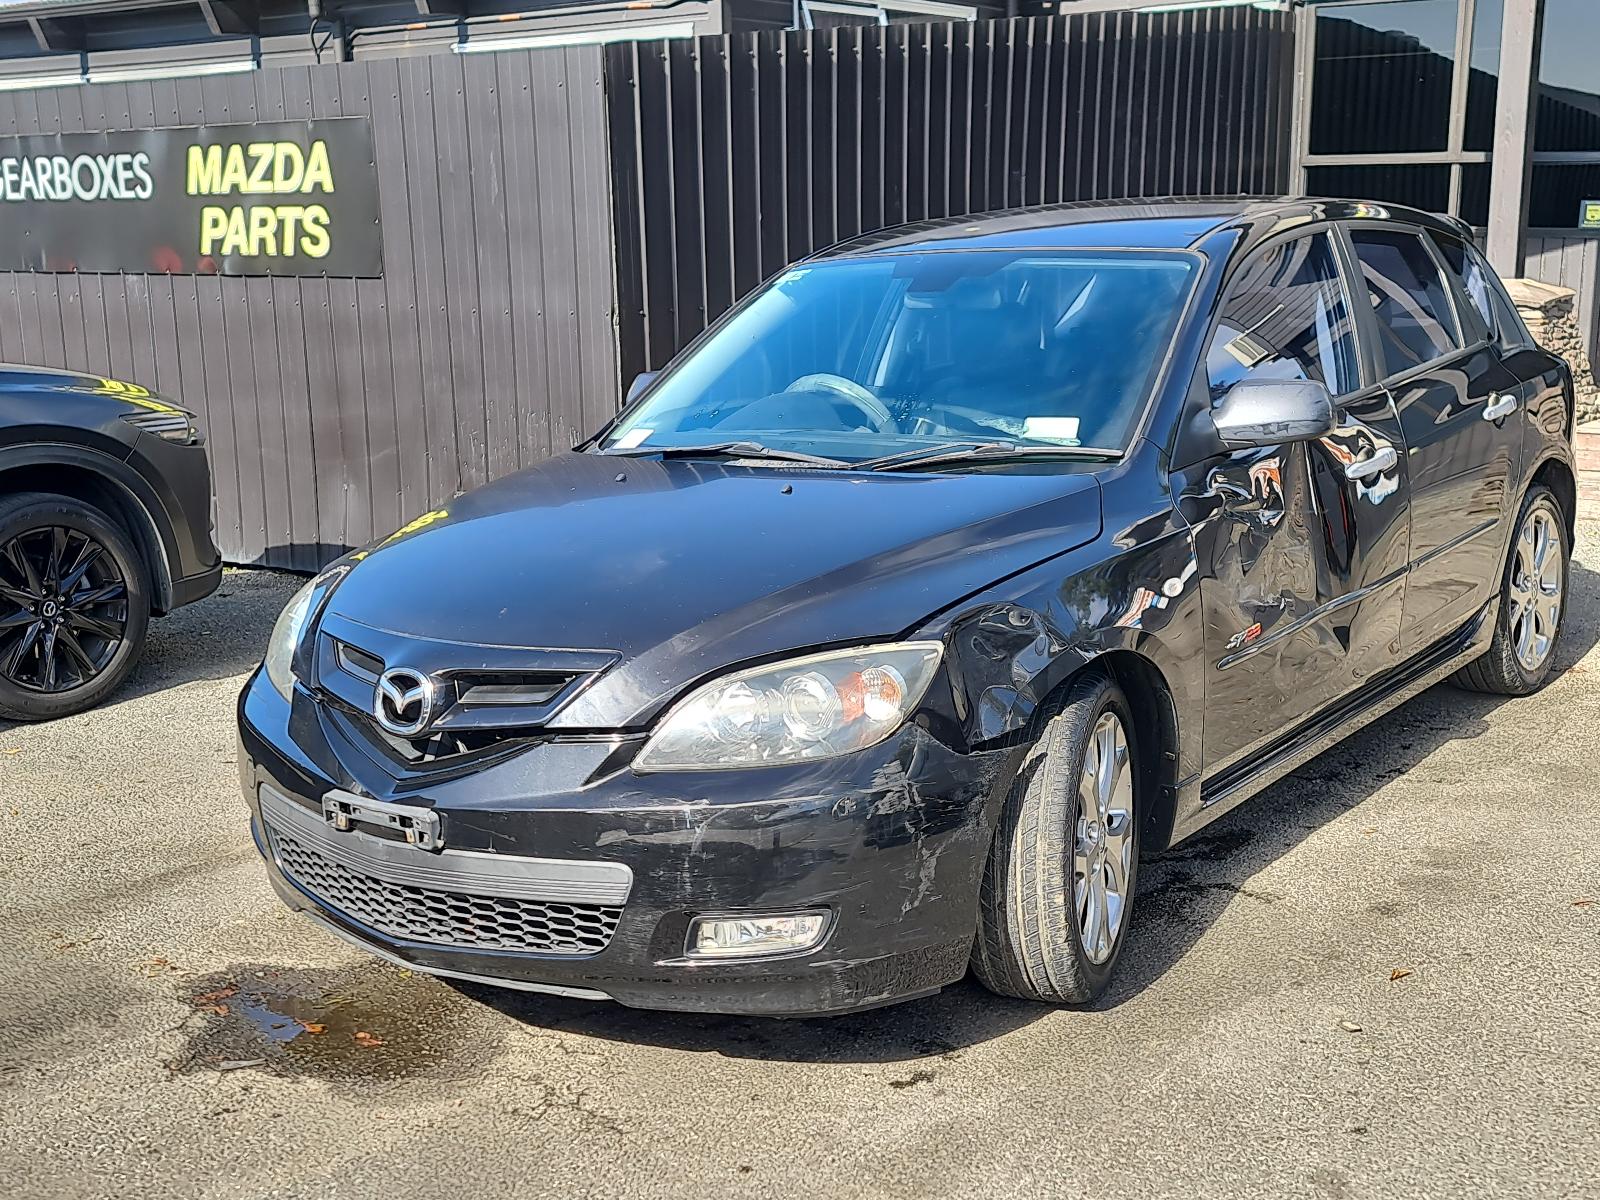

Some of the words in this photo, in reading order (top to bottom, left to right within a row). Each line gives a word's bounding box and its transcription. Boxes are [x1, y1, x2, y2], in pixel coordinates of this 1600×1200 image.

[0, 152, 153, 200] EARBOXES
[186, 140, 335, 195] MAZDA
[200, 204, 331, 258] PARTS
